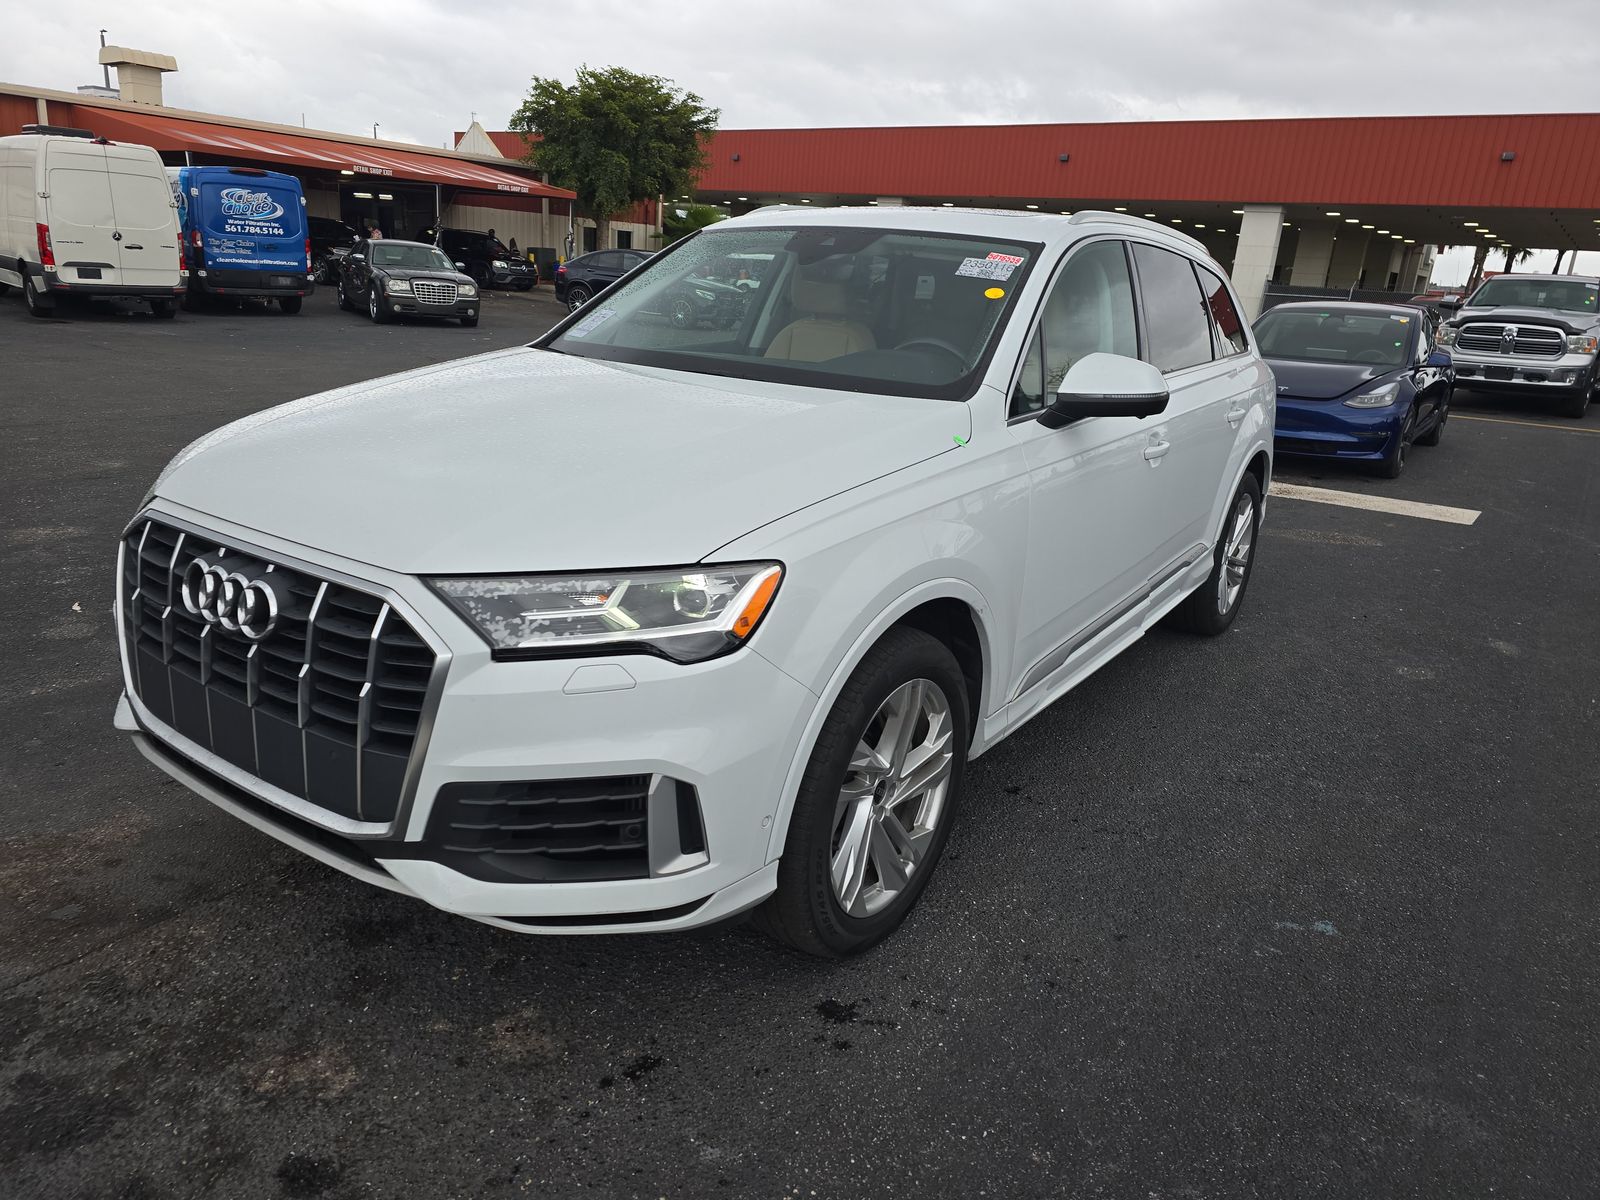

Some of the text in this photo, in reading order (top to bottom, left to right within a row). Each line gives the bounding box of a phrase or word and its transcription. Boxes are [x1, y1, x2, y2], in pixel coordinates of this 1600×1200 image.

[353, 165, 369, 173] DETAIL
[370, 167, 383, 175] SHOP
[233, 189, 269, 204] Clear
[222, 200, 273, 215] Choice
[246, 219, 271, 227] Filtration
[224, 225, 284, 235] 561.784.5144
[216, 257, 298, 266] clearchoicewaterfiltration.com
